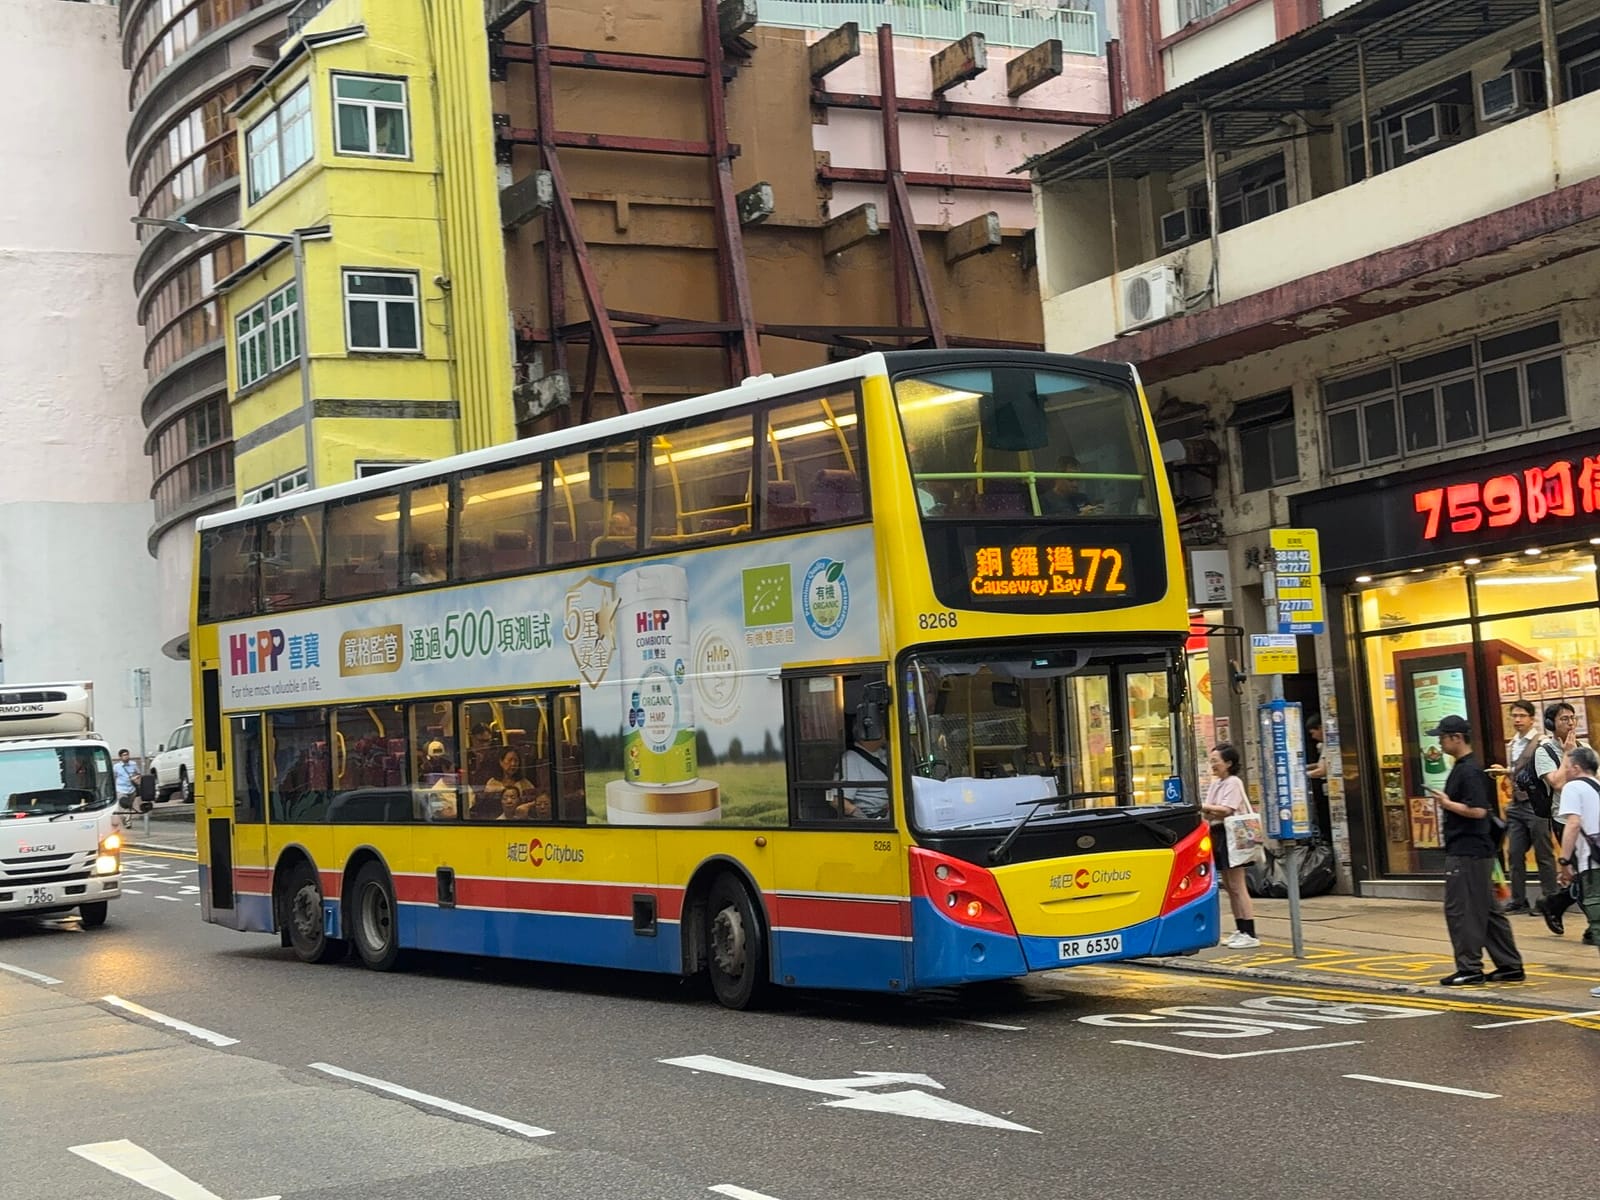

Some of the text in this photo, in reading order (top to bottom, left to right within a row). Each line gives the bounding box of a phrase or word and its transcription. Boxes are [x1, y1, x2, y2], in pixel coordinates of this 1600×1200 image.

[976, 547, 1075, 577] 銅鑼灣
[1080, 548, 1127, 592] 72
[971, 575, 1083, 597] Causeway Bay
[812, 600, 840, 610] ORGANIC
[563, 591, 598, 642] 5星
[636, 609, 670, 634] HiPP
[918, 612, 958, 630] 8268
[409, 609, 552, 662] 通過500項測試
[636, 635, 673, 648] COMBIOTIC
[229, 629, 321, 676] HiPP 喜寶
[344, 633, 398, 668] 嚴格監管
[579, 640, 609, 670] 安全
[706, 645, 730, 663] HMP
[231, 686, 242, 699] For
[242, 684, 254, 698] the
[254, 683, 271, 697] most
[272, 679, 300, 695] valuable
[22, 704, 44, 712] KING
[641, 696, 673, 707] ORGANIC
[507, 842, 585, 864] 城巴 Citybus
[873, 840, 892, 852] 8268
[1048, 869, 1132, 890] 城巴 Citybus
[27, 893, 54, 905] 7200
[1062, 937, 1119, 958] RR 6530
